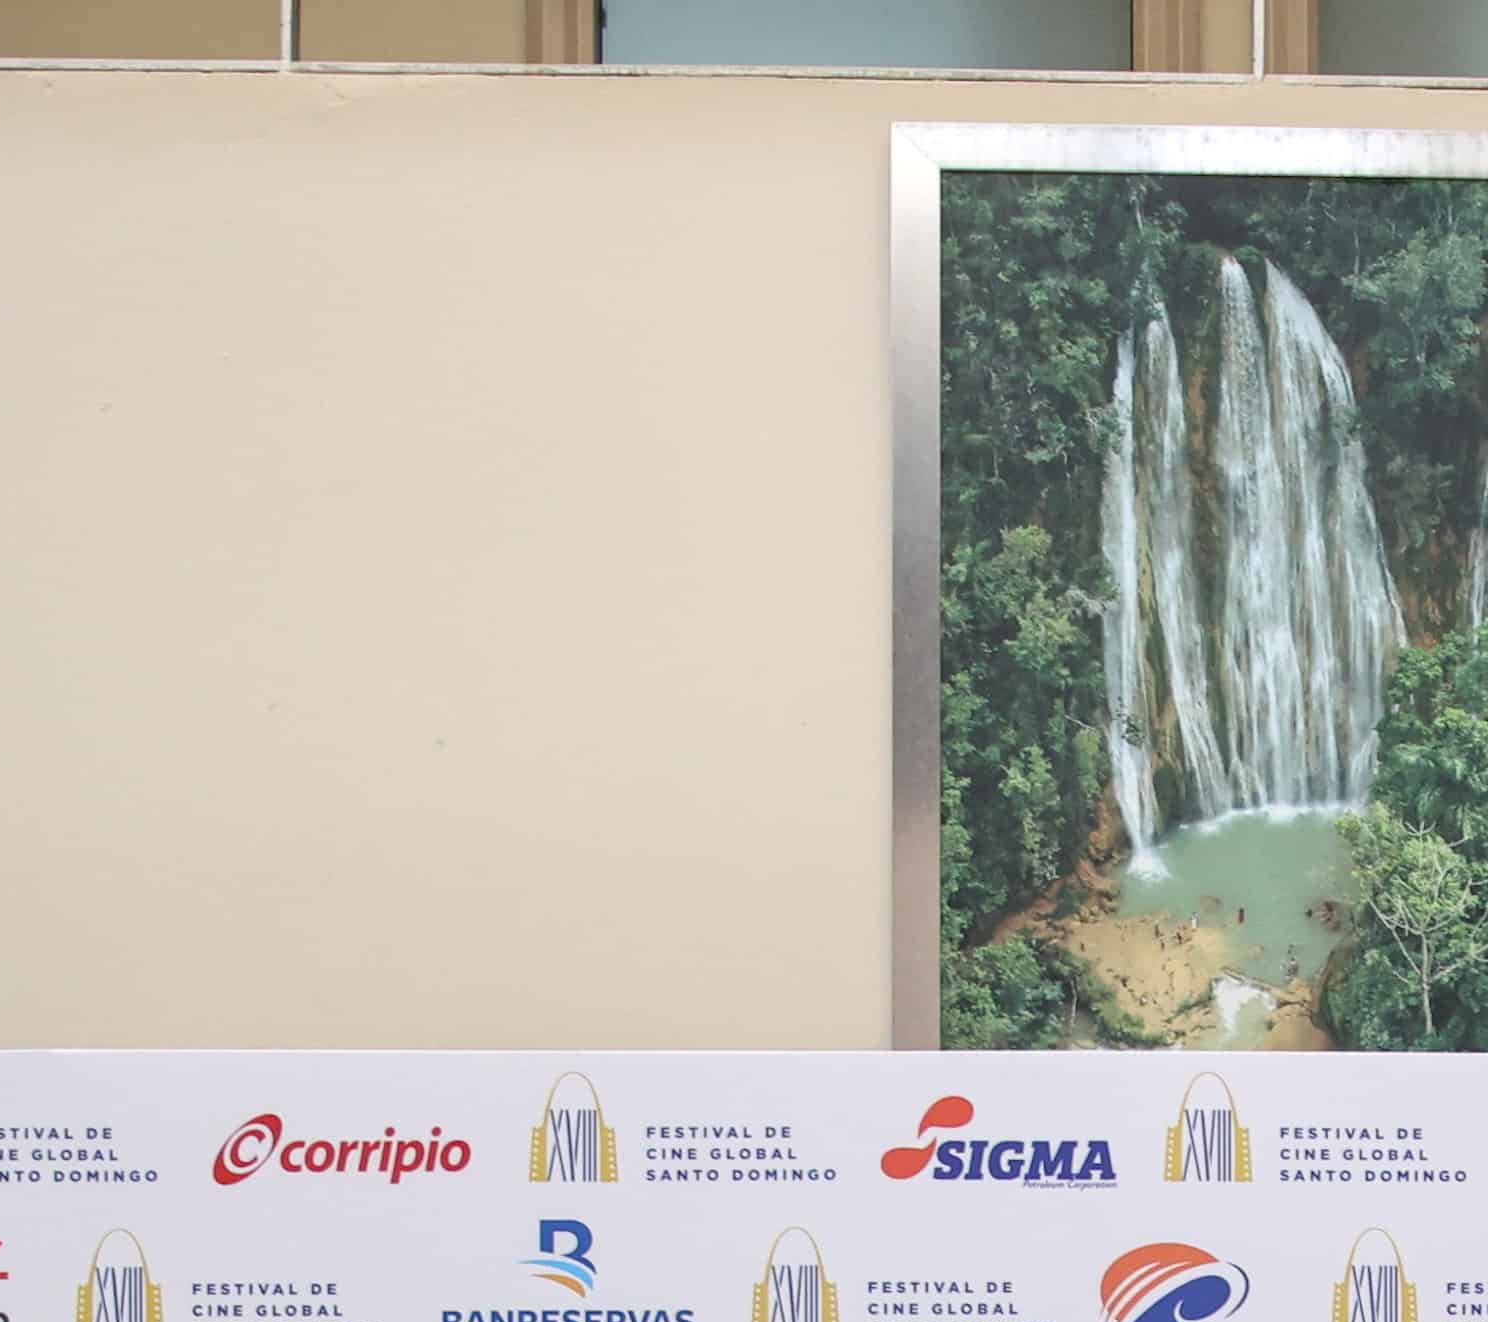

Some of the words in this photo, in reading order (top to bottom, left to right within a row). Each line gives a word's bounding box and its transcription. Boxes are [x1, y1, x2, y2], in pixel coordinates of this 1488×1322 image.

[86, 1127, 113, 1140] DE
[1279, 1127, 1385, 1140] FESTIVAL
[1396, 1127, 1422, 1140] DE
[31, 1148, 118, 1161] GLOBAL
[280, 1127, 472, 1184] corripio
[933, 1140, 1117, 1180] SIGMA
[1279, 1148, 1330, 1161] CINE
[1342, 1148, 1428, 1161] GLOBAL
[53, 1169, 158, 1183] DOMINGO
[1279, 1169, 1352, 1182] SANTO
[1364, 1169, 1467, 1183] DOMINGO
[192, 1283, 298, 1296] FESTIVAL
[310, 1283, 337, 1296] DE
[867, 1281, 974, 1294] FESTIVAL
[986, 1281, 1013, 1294] DE
[192, 1304, 243, 1317] CINE
[255, 1304, 343, 1317] GLOBAL
[867, 1302, 919, 1316] CINE
[931, 1302, 1019, 1316] GLOBAL
